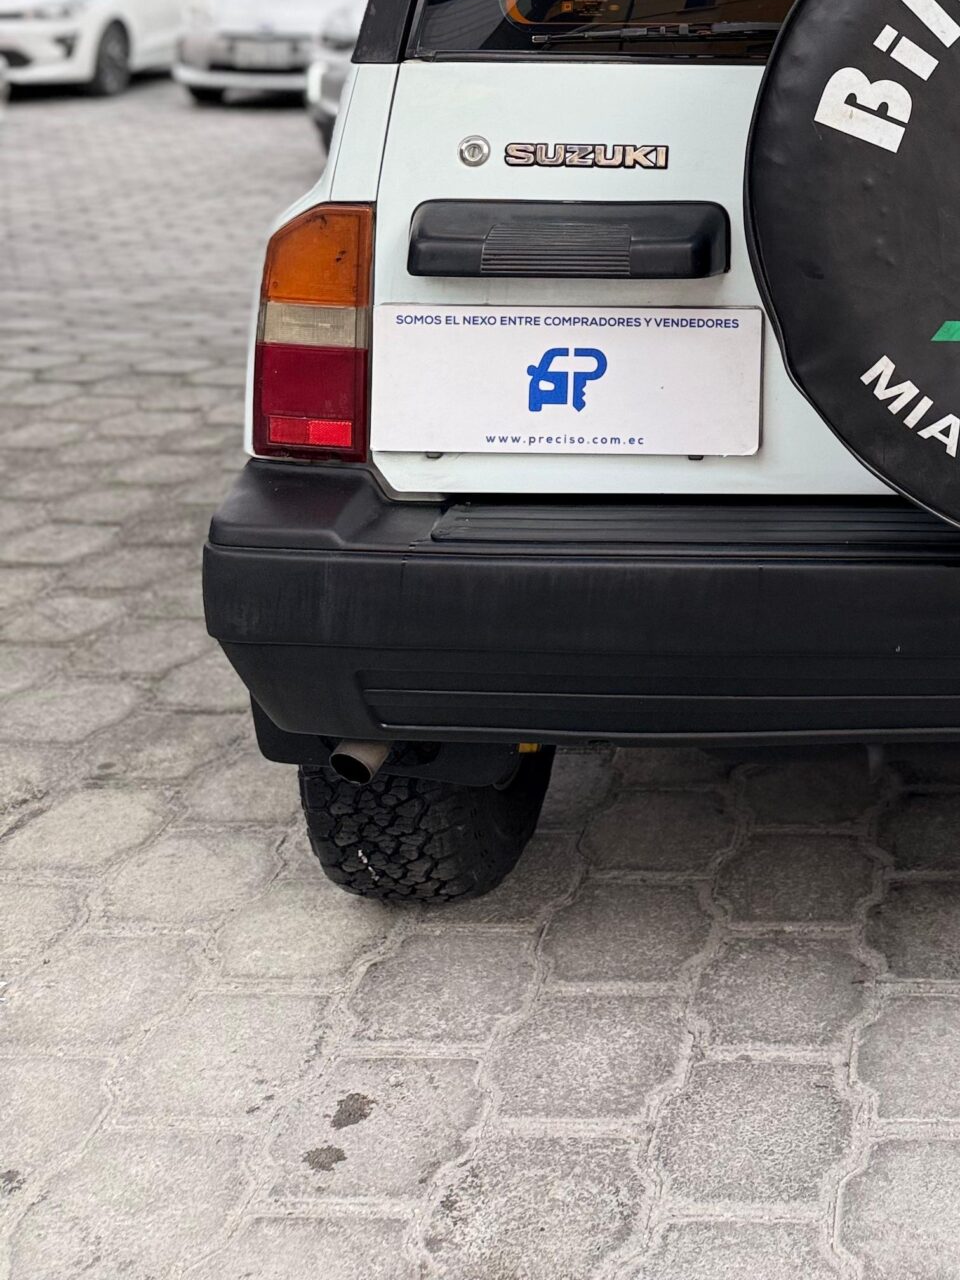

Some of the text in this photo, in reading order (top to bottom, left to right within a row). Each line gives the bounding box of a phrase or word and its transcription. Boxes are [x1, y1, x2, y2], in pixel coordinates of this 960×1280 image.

[504, 142, 670, 169] SUZUKI
[396, 314, 740, 329] SOMOS EL NEXO ENTRE COMPRADORES Y VENDEDORES
[485, 434, 644, 447] www.preciso.com.ec
